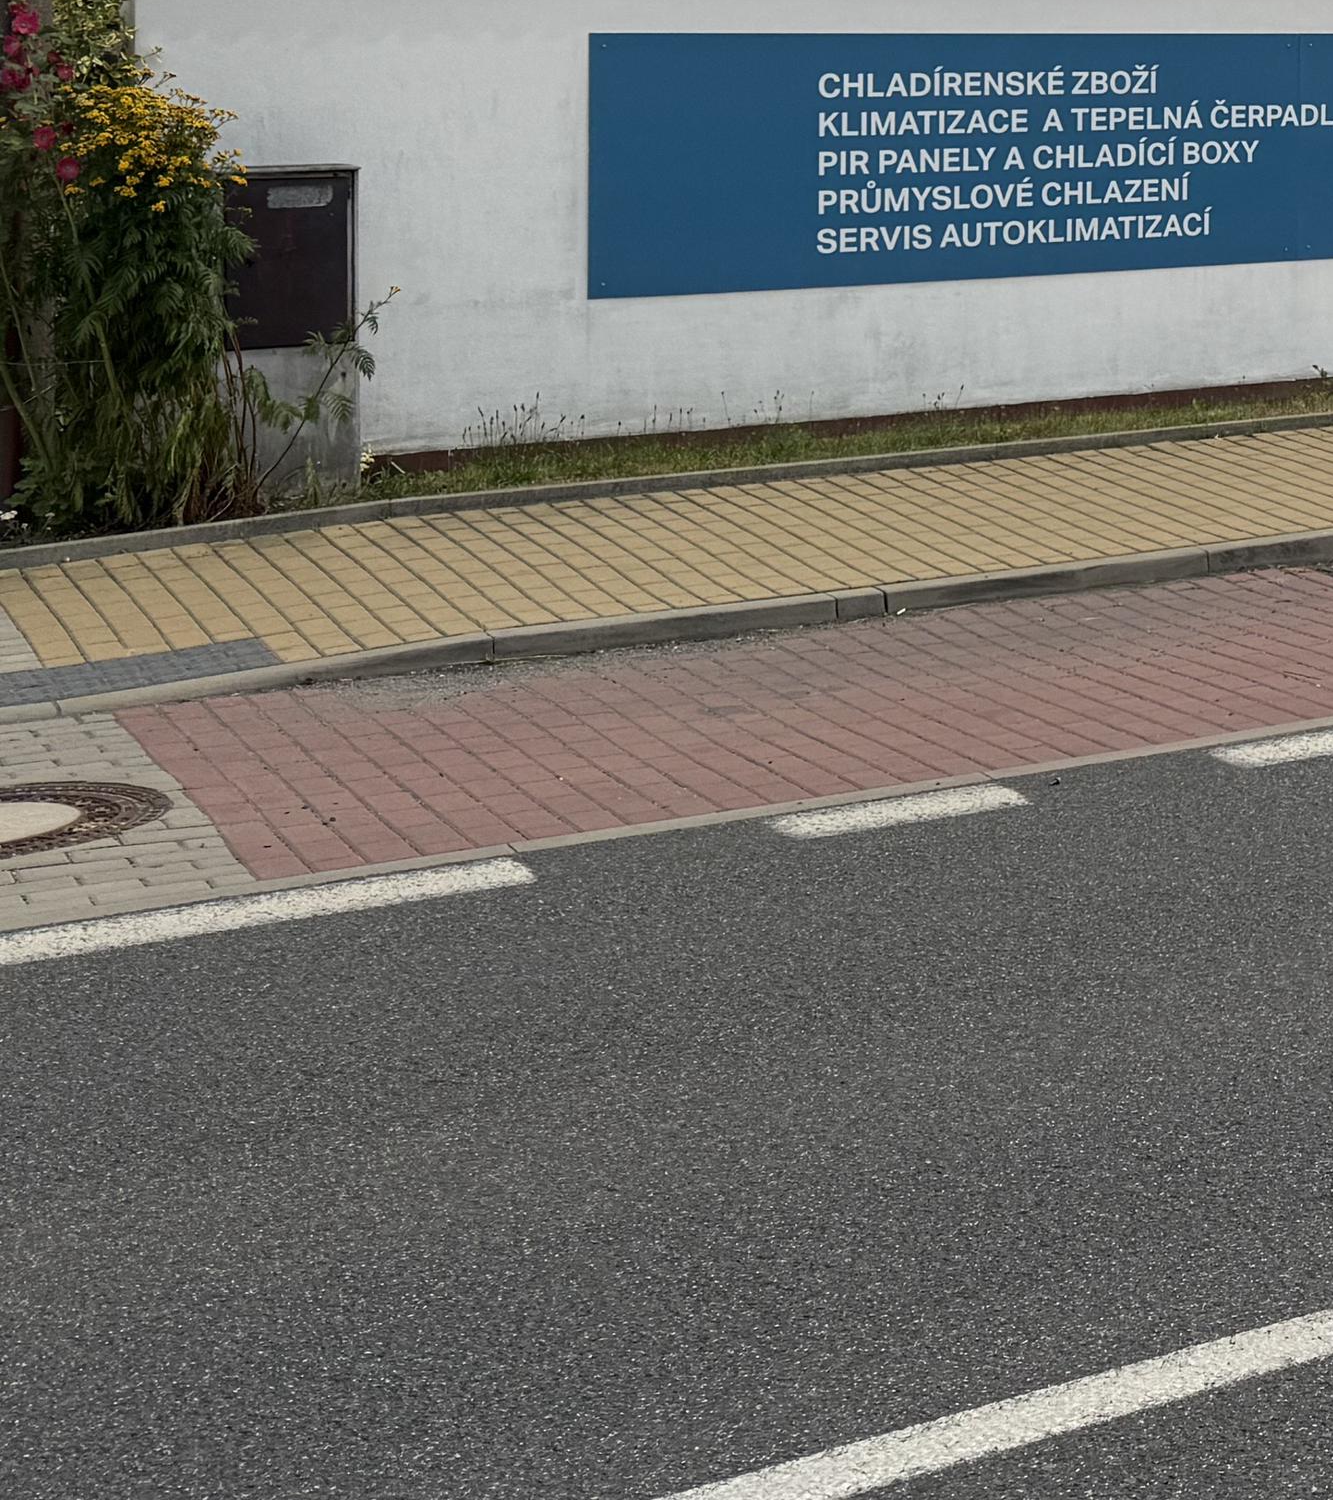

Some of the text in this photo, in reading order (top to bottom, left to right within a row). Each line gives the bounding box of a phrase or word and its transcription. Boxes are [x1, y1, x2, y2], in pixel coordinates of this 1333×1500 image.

[818, 64, 1158, 99] CHLADÍRENSKÉ ZBOŽÍ
[818, 107, 1029, 138] KLIMATIZACE
[1042, 108, 1065, 133] A
[1070, 100, 1203, 133] TEPELNÁ
[818, 137, 1260, 176] PIR PANELY A CHLADÍCÍ BOXY
[817, 172, 1190, 215] PRŮMYSLOVÉ CHLAZENÍ
[816, 207, 1212, 254] SERVIS AUTOKLIMATIZACÍ
